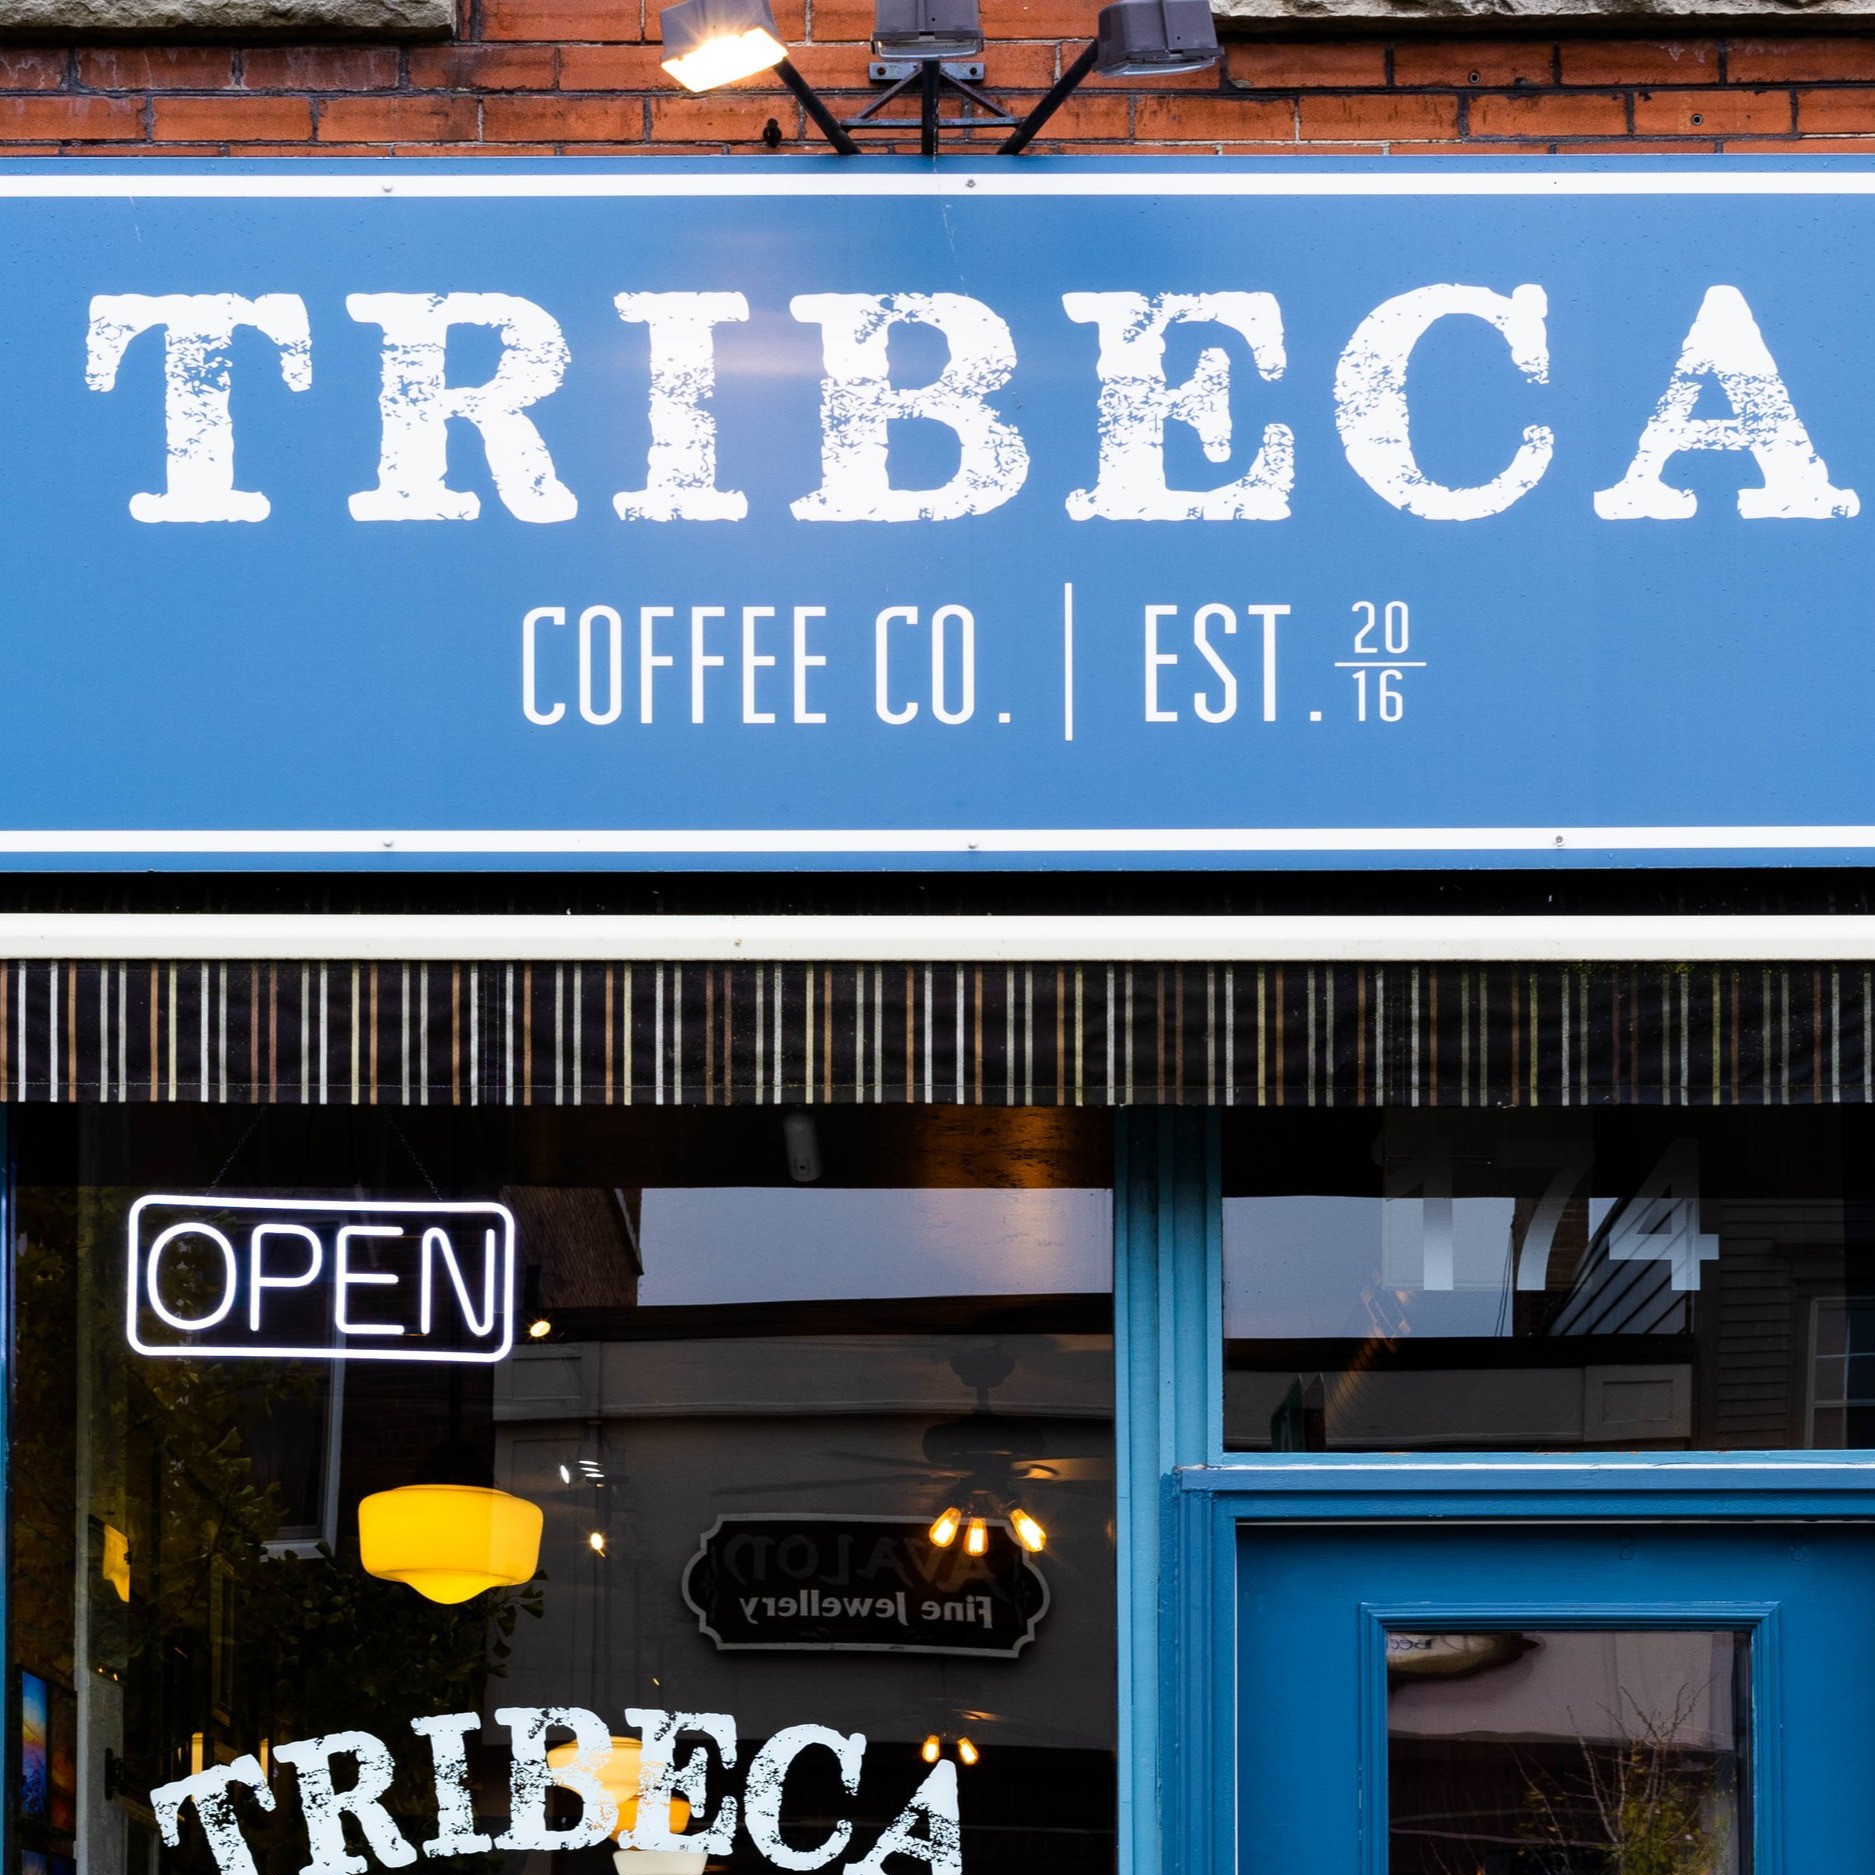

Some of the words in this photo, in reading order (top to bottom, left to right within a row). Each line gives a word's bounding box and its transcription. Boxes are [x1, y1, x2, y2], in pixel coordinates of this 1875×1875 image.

[85, 282, 1861, 524] TRIBECA
[522, 604, 827, 726] COFFEE
[875, 604, 1011, 726] CO.
[1144, 603, 1322, 724] EST.
[1351, 600, 1410, 655] 20
[1352, 668, 1404, 723] 16
[1386, 1136, 1720, 1291] 174
[146, 1221, 497, 1337] OPEN
